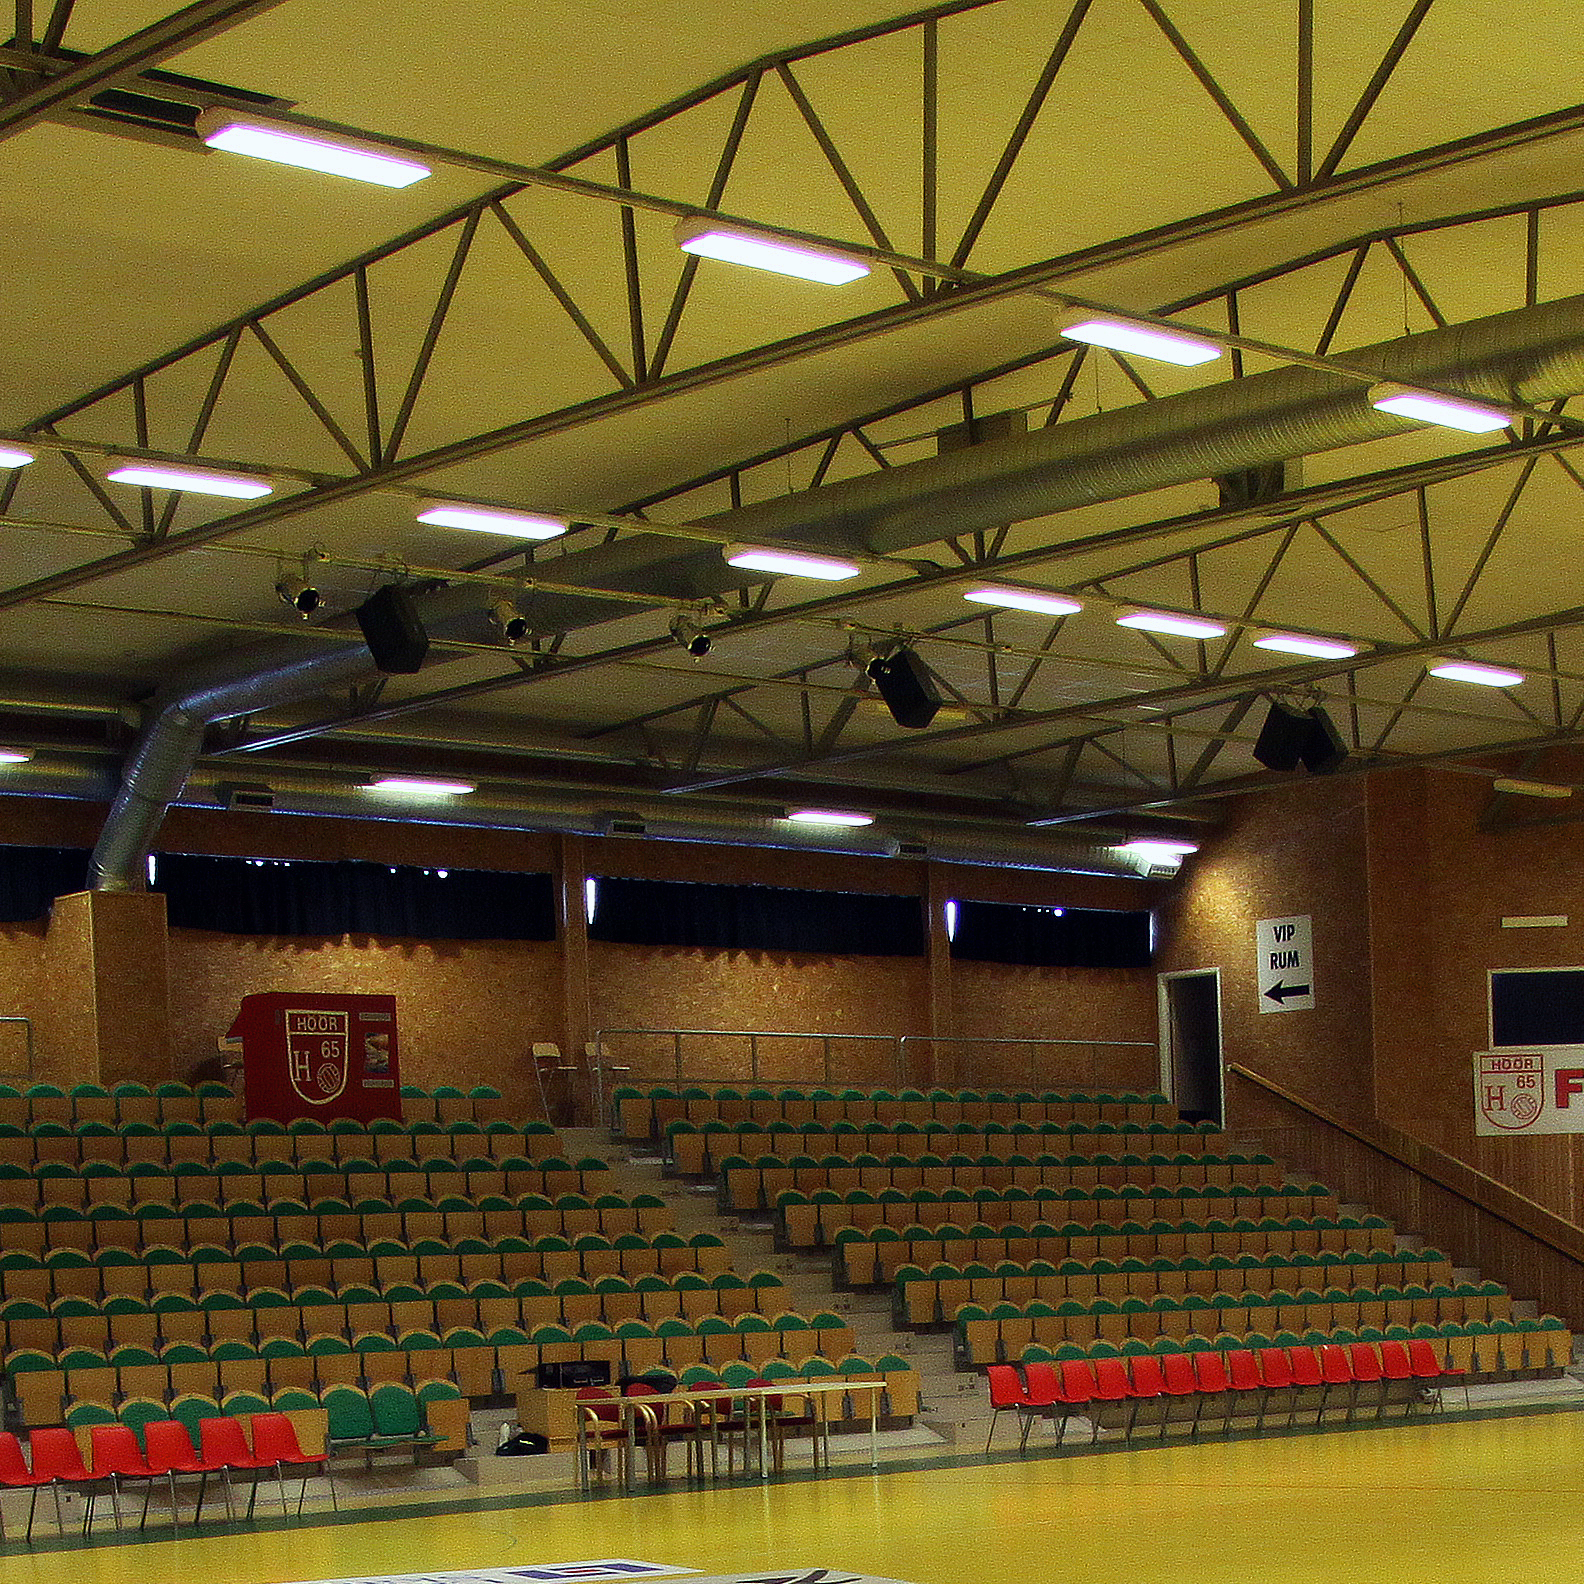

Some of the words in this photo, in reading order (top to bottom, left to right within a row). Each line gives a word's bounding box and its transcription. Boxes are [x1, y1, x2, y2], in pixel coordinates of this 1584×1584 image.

[1273, 924, 1295, 943] VIP
[1270, 950, 1300, 970] RUM
[297, 1014, 338, 1031] HÖÖR
[321, 1040, 340, 1058] 65
[293, 1050, 312, 1082] H
[1517, 1075, 1536, 1089] 65
[1484, 1085, 1507, 1111] H
